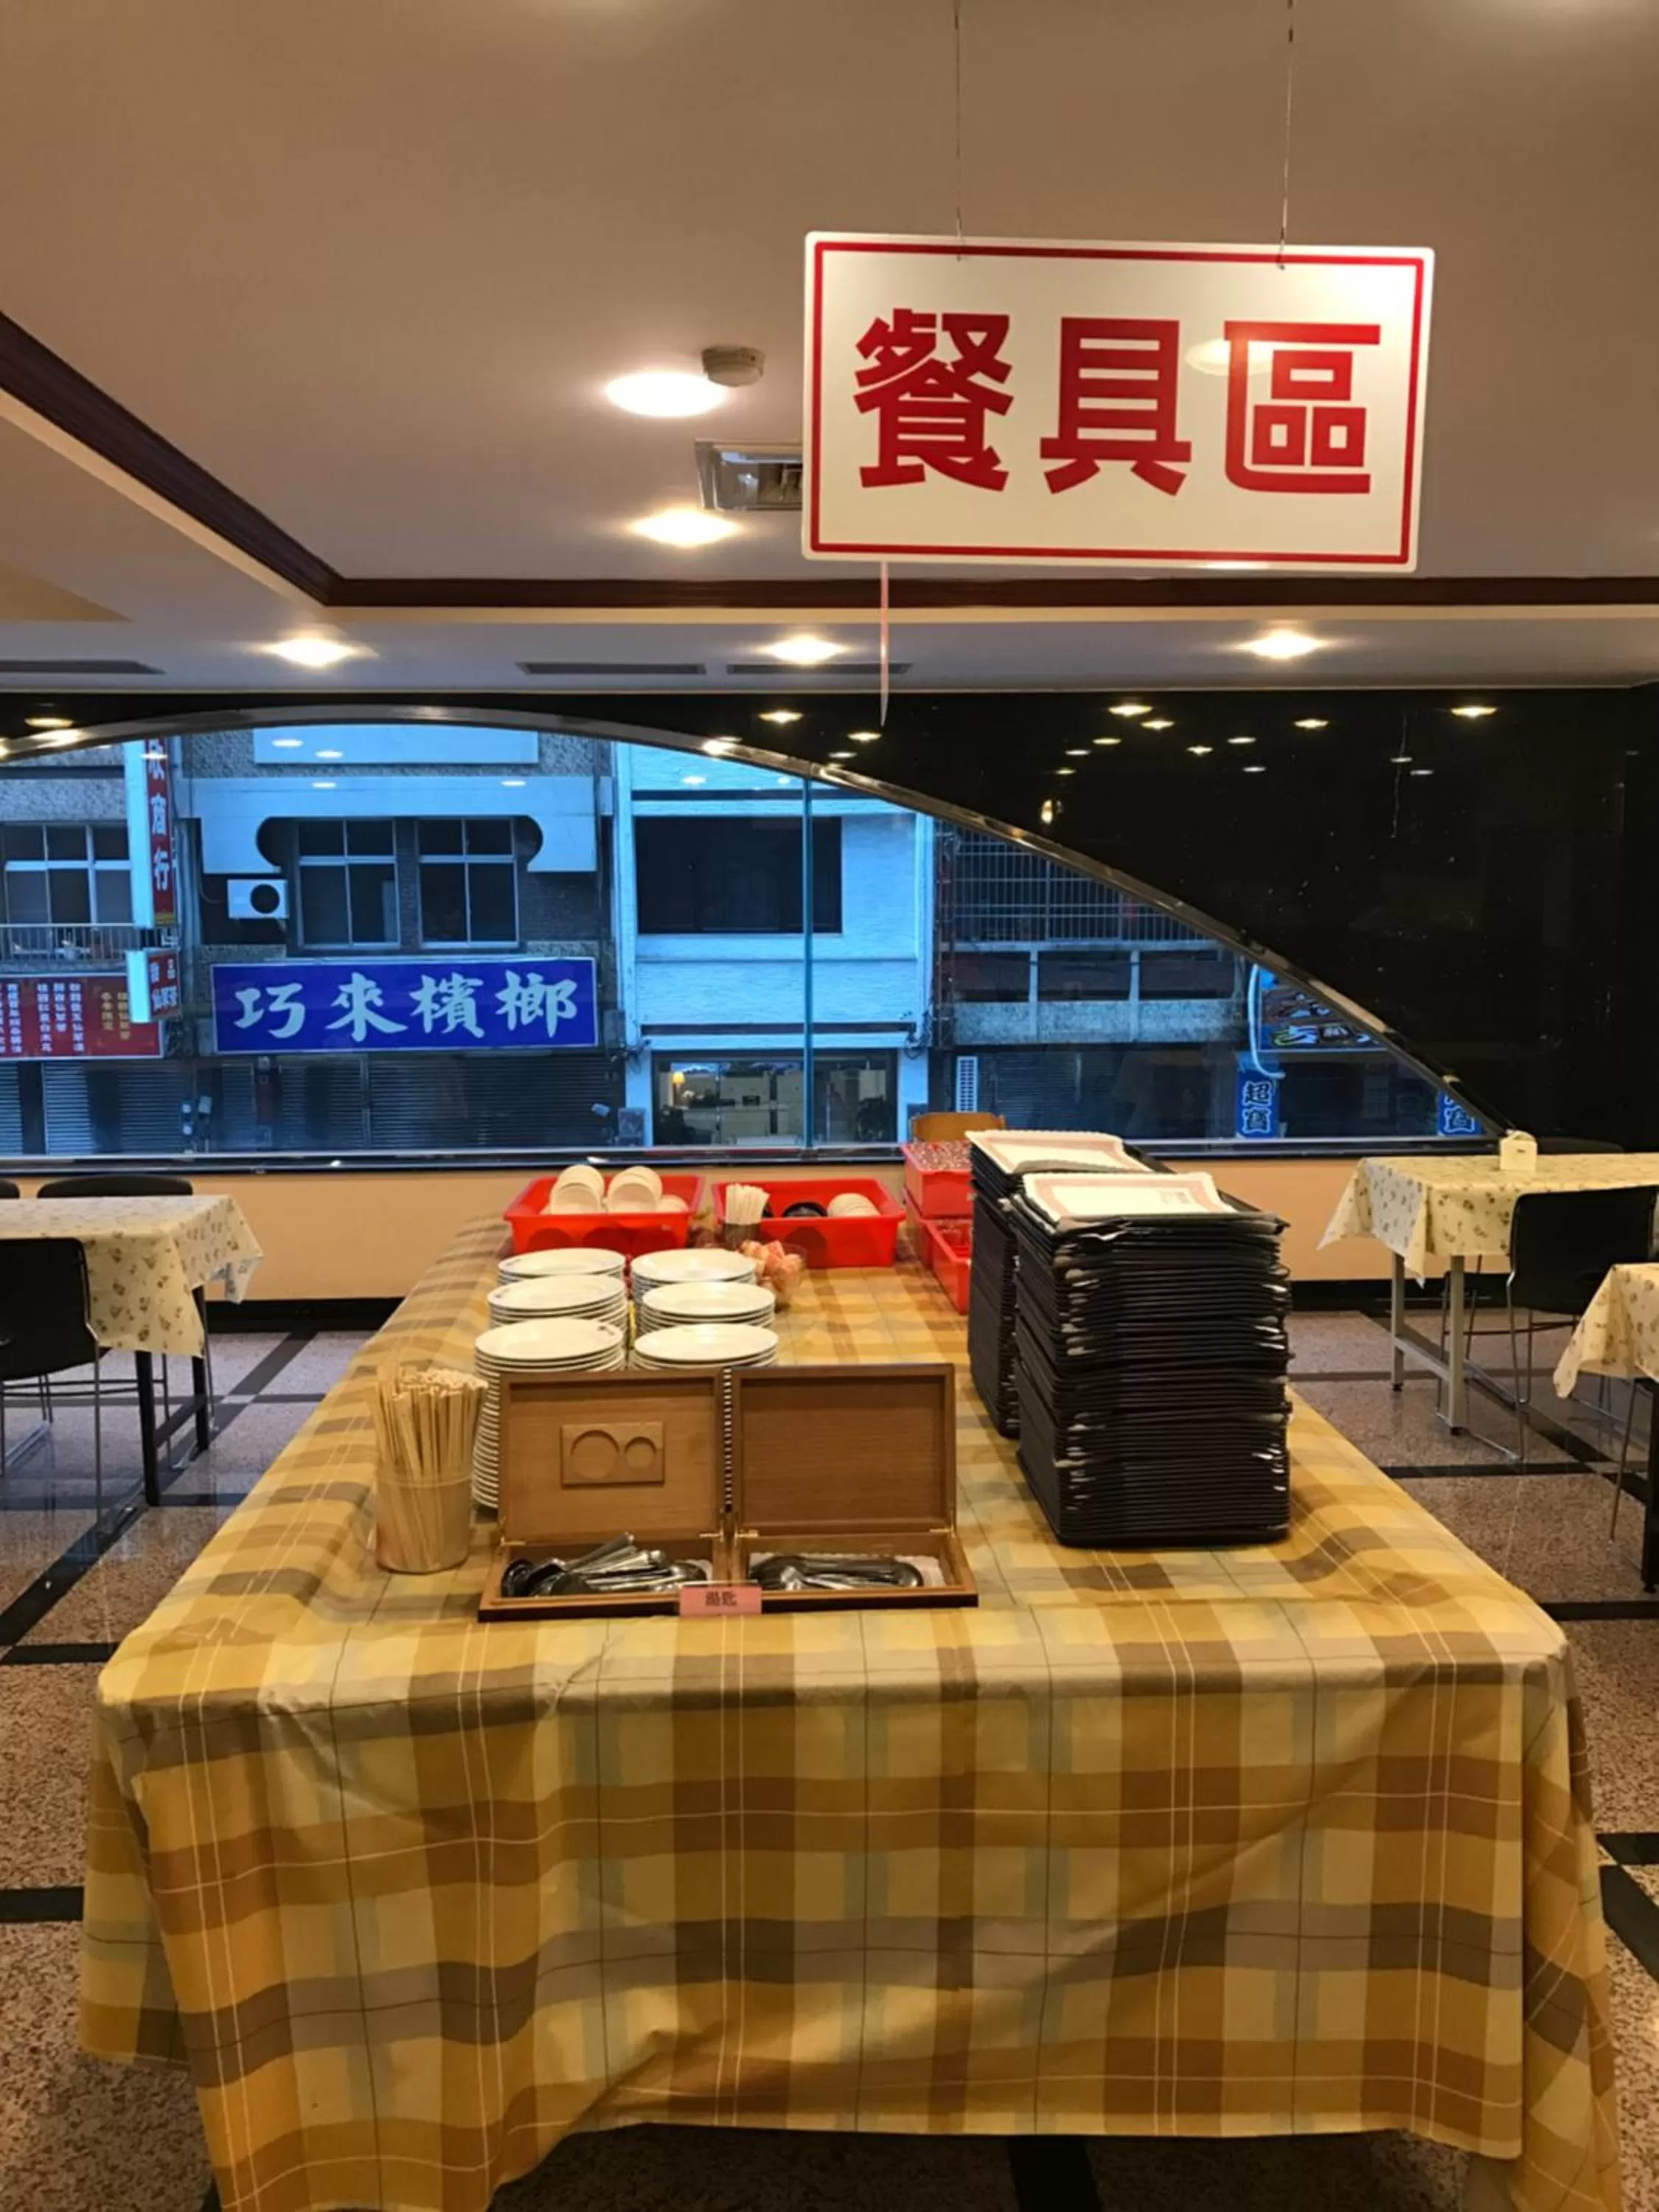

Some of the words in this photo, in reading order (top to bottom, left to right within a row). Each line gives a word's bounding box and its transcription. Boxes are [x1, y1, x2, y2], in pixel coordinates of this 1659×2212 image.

[854, 307, 1381, 496] 餐具區
[234, 970, 579, 1043] 巧來檳榔
